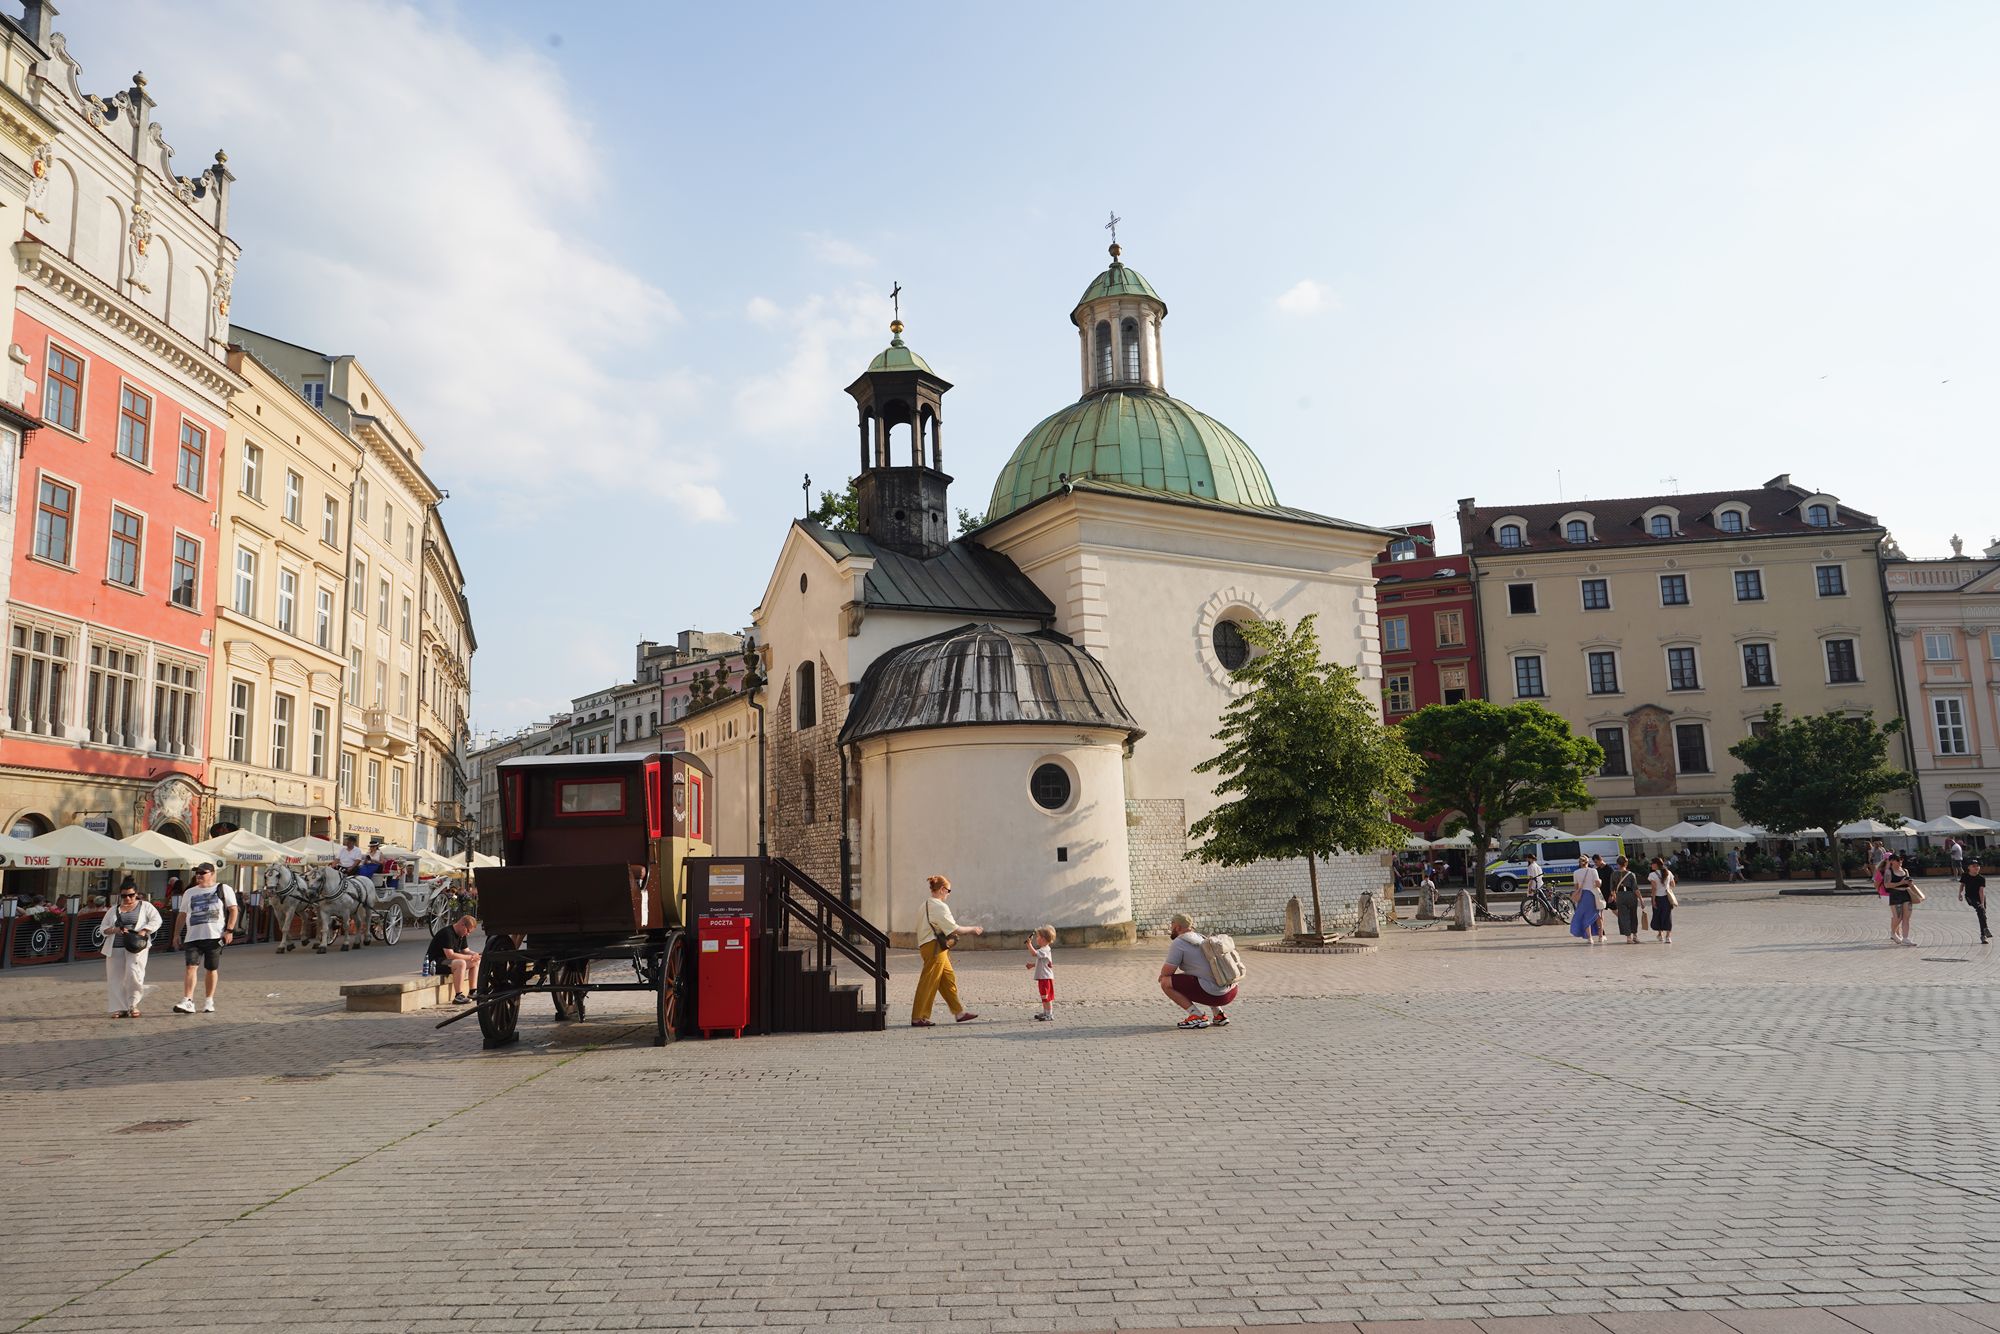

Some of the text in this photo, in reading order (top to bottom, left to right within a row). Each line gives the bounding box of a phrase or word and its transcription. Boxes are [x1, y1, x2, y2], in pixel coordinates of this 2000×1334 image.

[24, 855, 51, 866] TYSKIE
[237, 852, 263, 861] Pijalnia
[65, 857, 106, 867] TYSKIE
